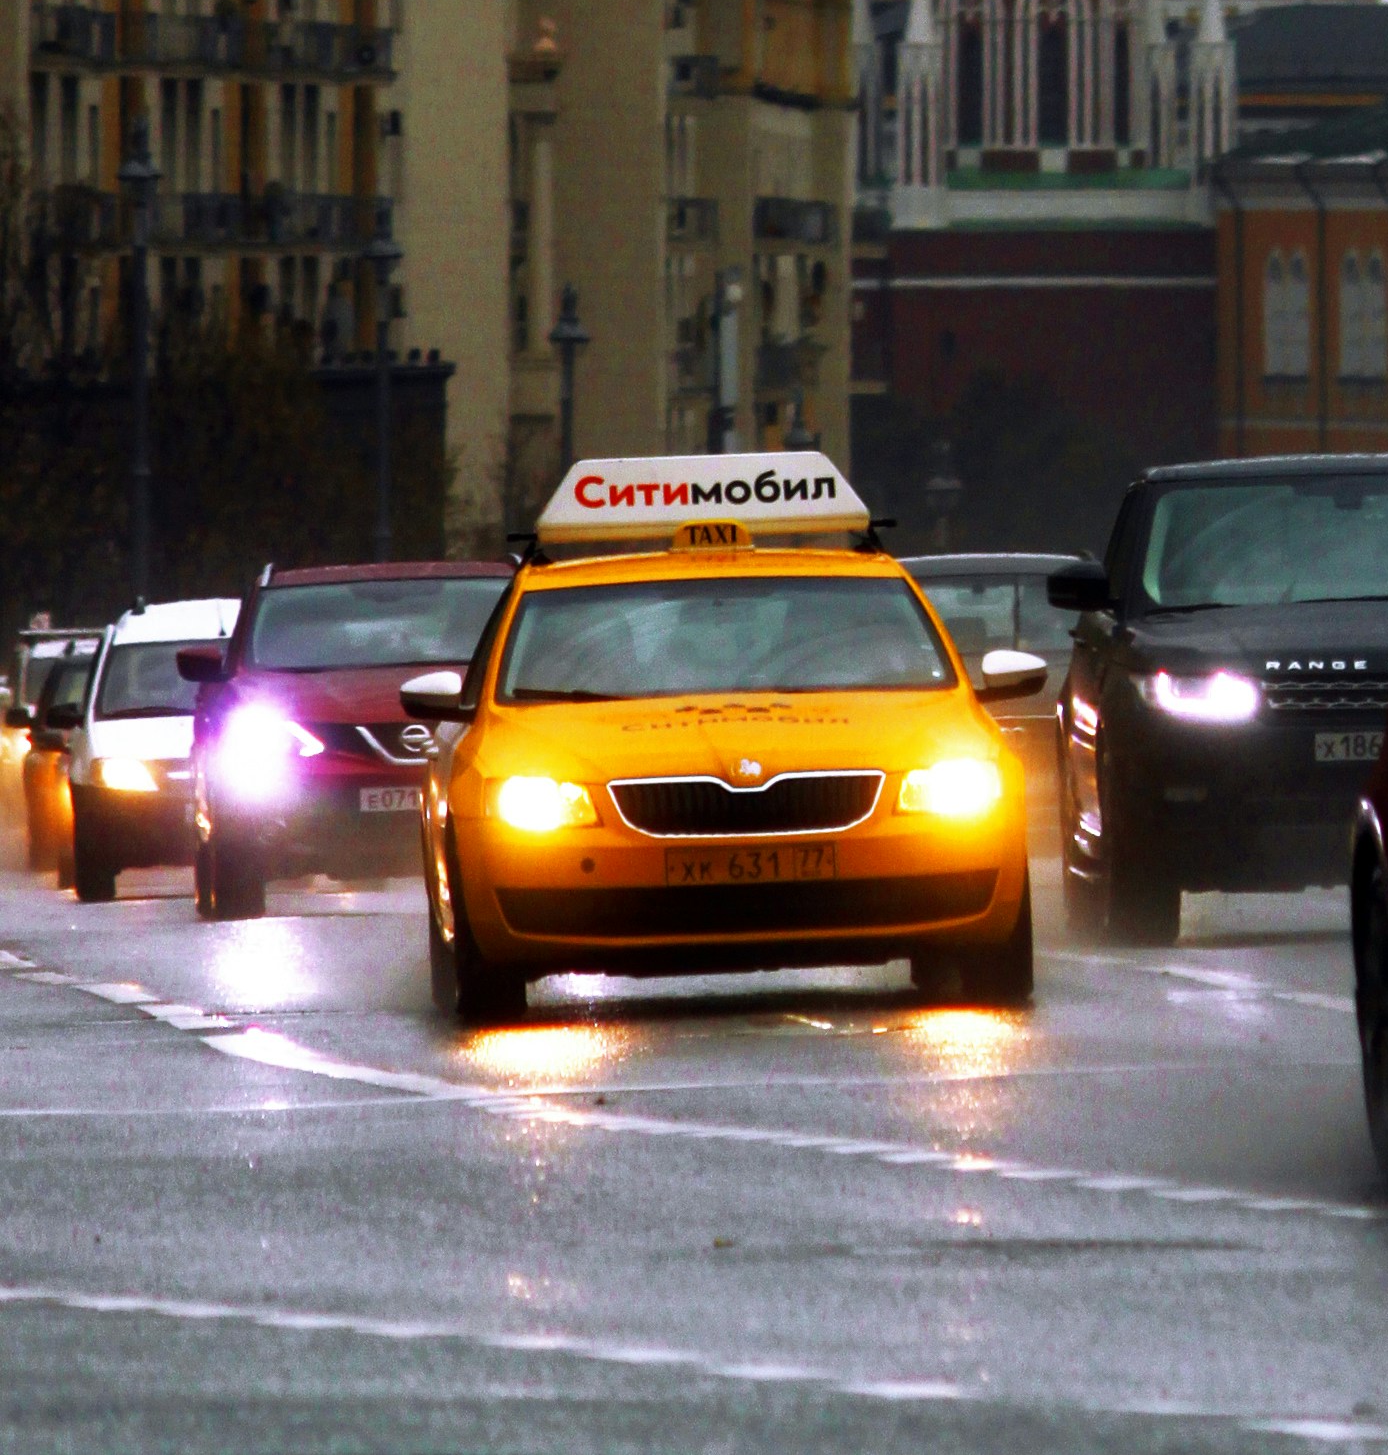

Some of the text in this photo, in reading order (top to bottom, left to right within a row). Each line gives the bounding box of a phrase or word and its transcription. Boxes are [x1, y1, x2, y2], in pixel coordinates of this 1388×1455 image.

[574, 469, 836, 509] Ситимобил
[683, 524, 738, 544] TAXI
[1265, 659, 1368, 671] RANGE
[728, 850, 780, 879] 631
[801, 848, 825, 868] 77
